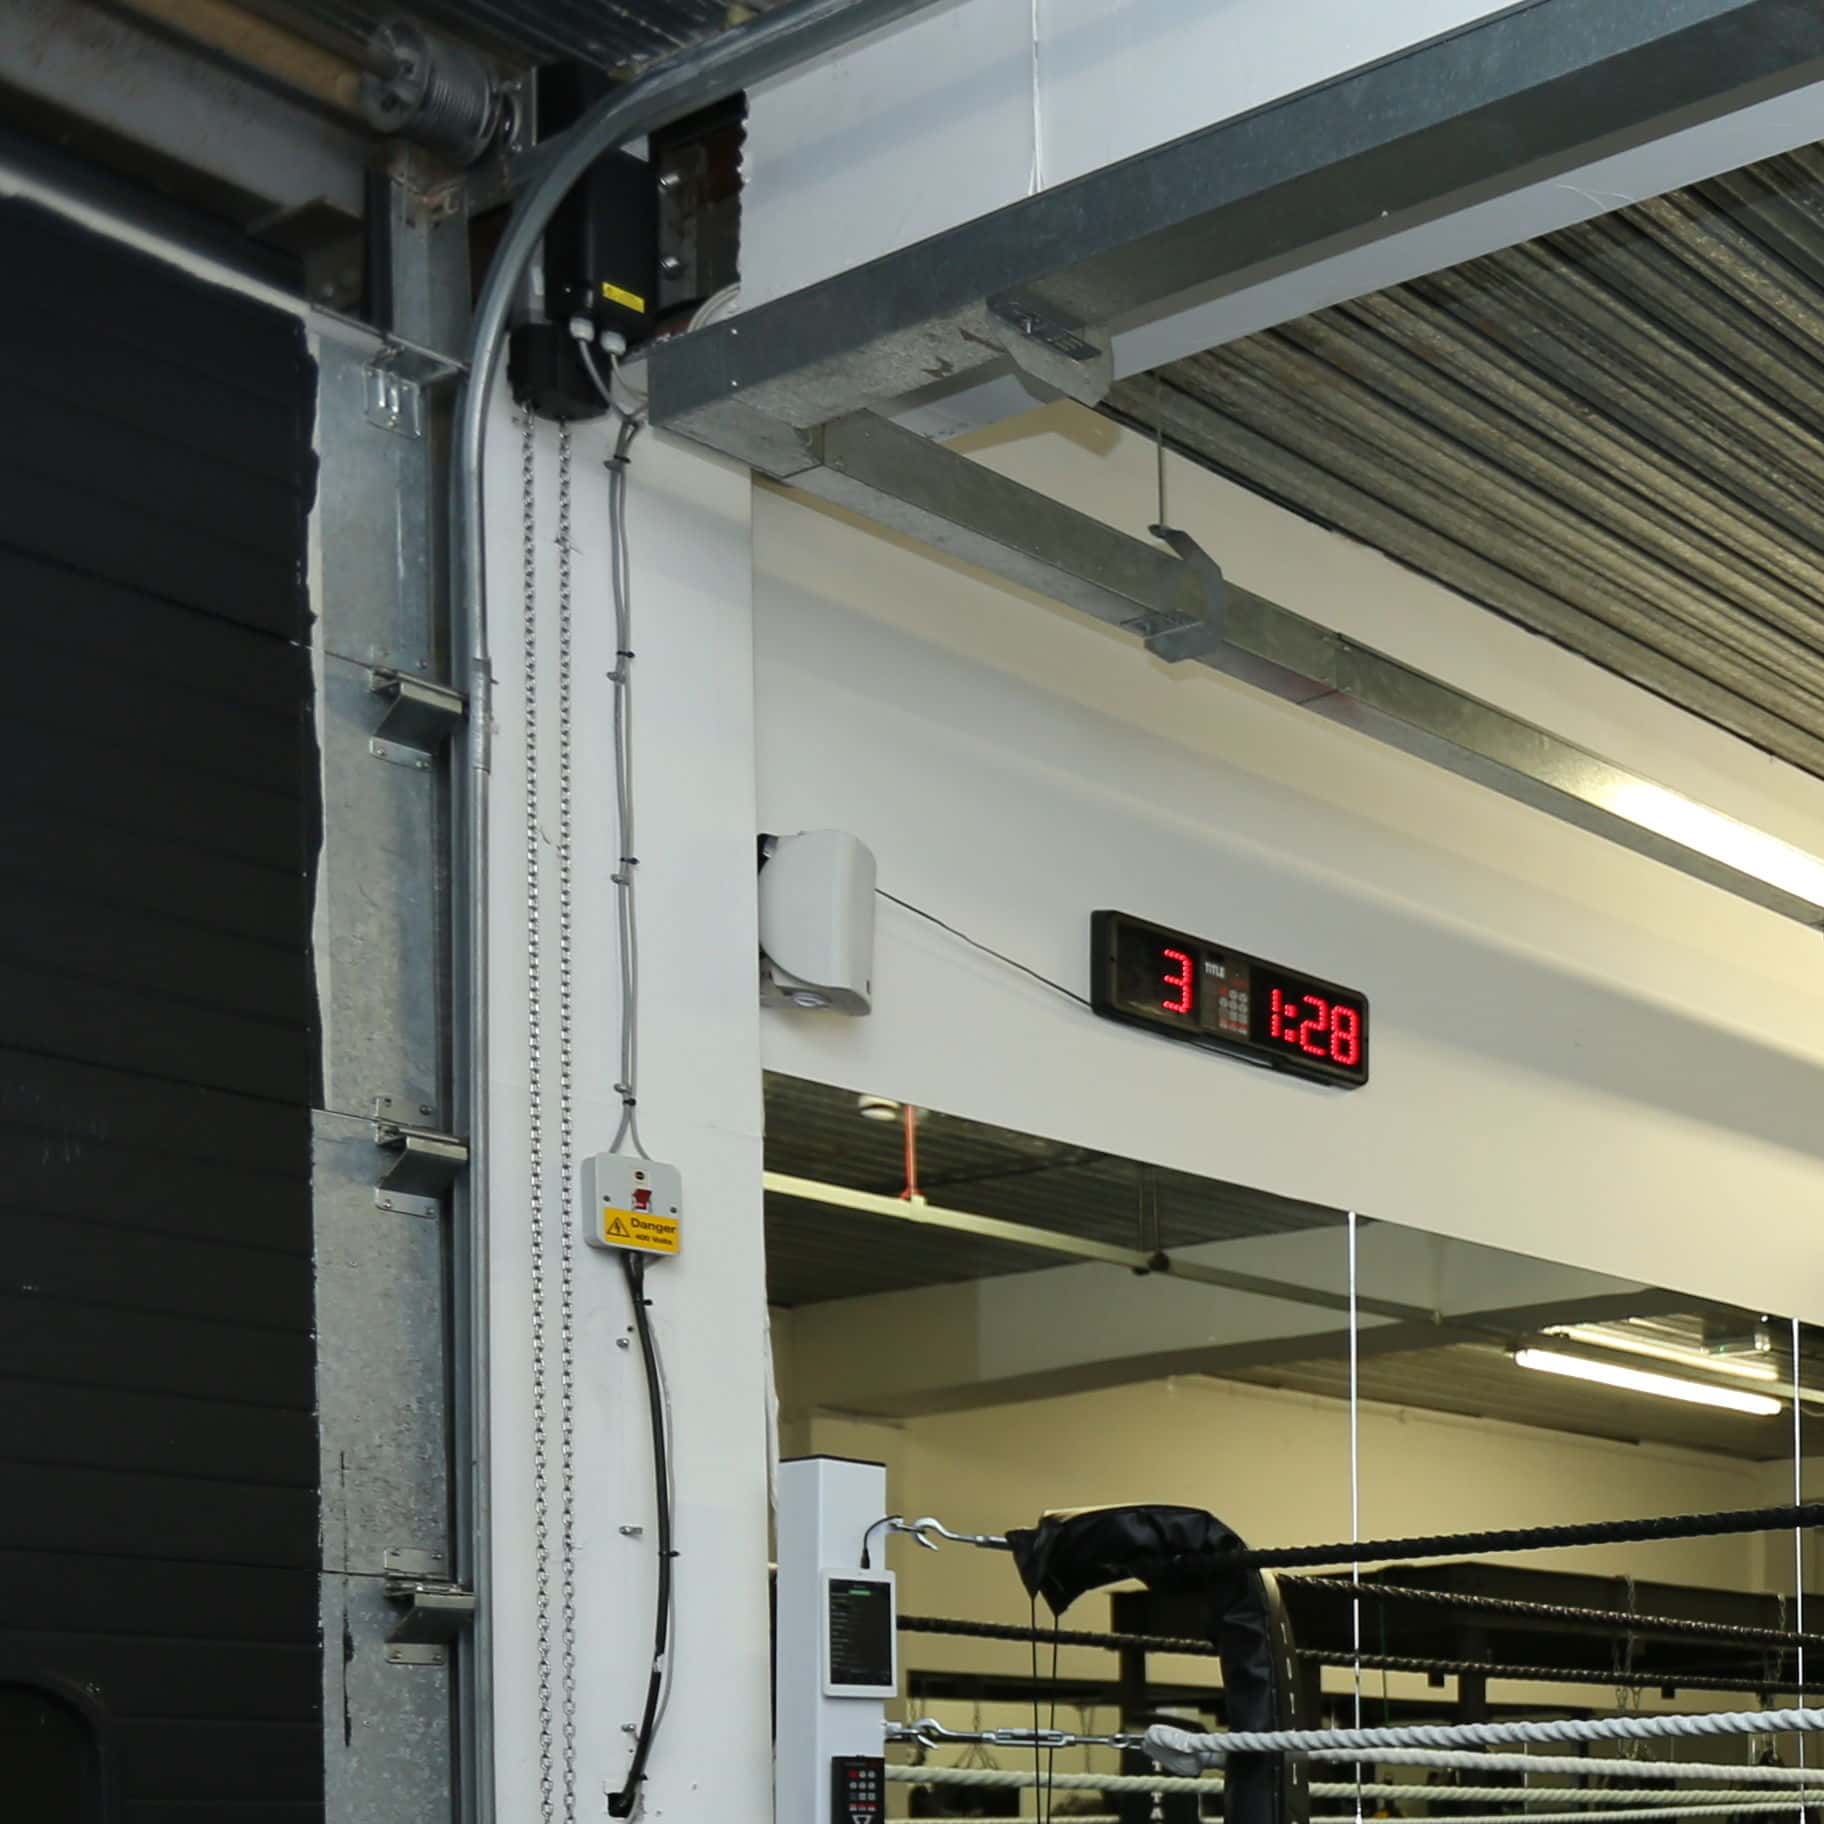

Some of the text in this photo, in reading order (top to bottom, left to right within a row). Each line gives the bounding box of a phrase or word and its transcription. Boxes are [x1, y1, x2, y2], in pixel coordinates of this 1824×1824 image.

[1164, 948, 1192, 1013] 3
[1270, 988, 1360, 1065] 1:28
[630, 1217, 676, 1233] Danger
